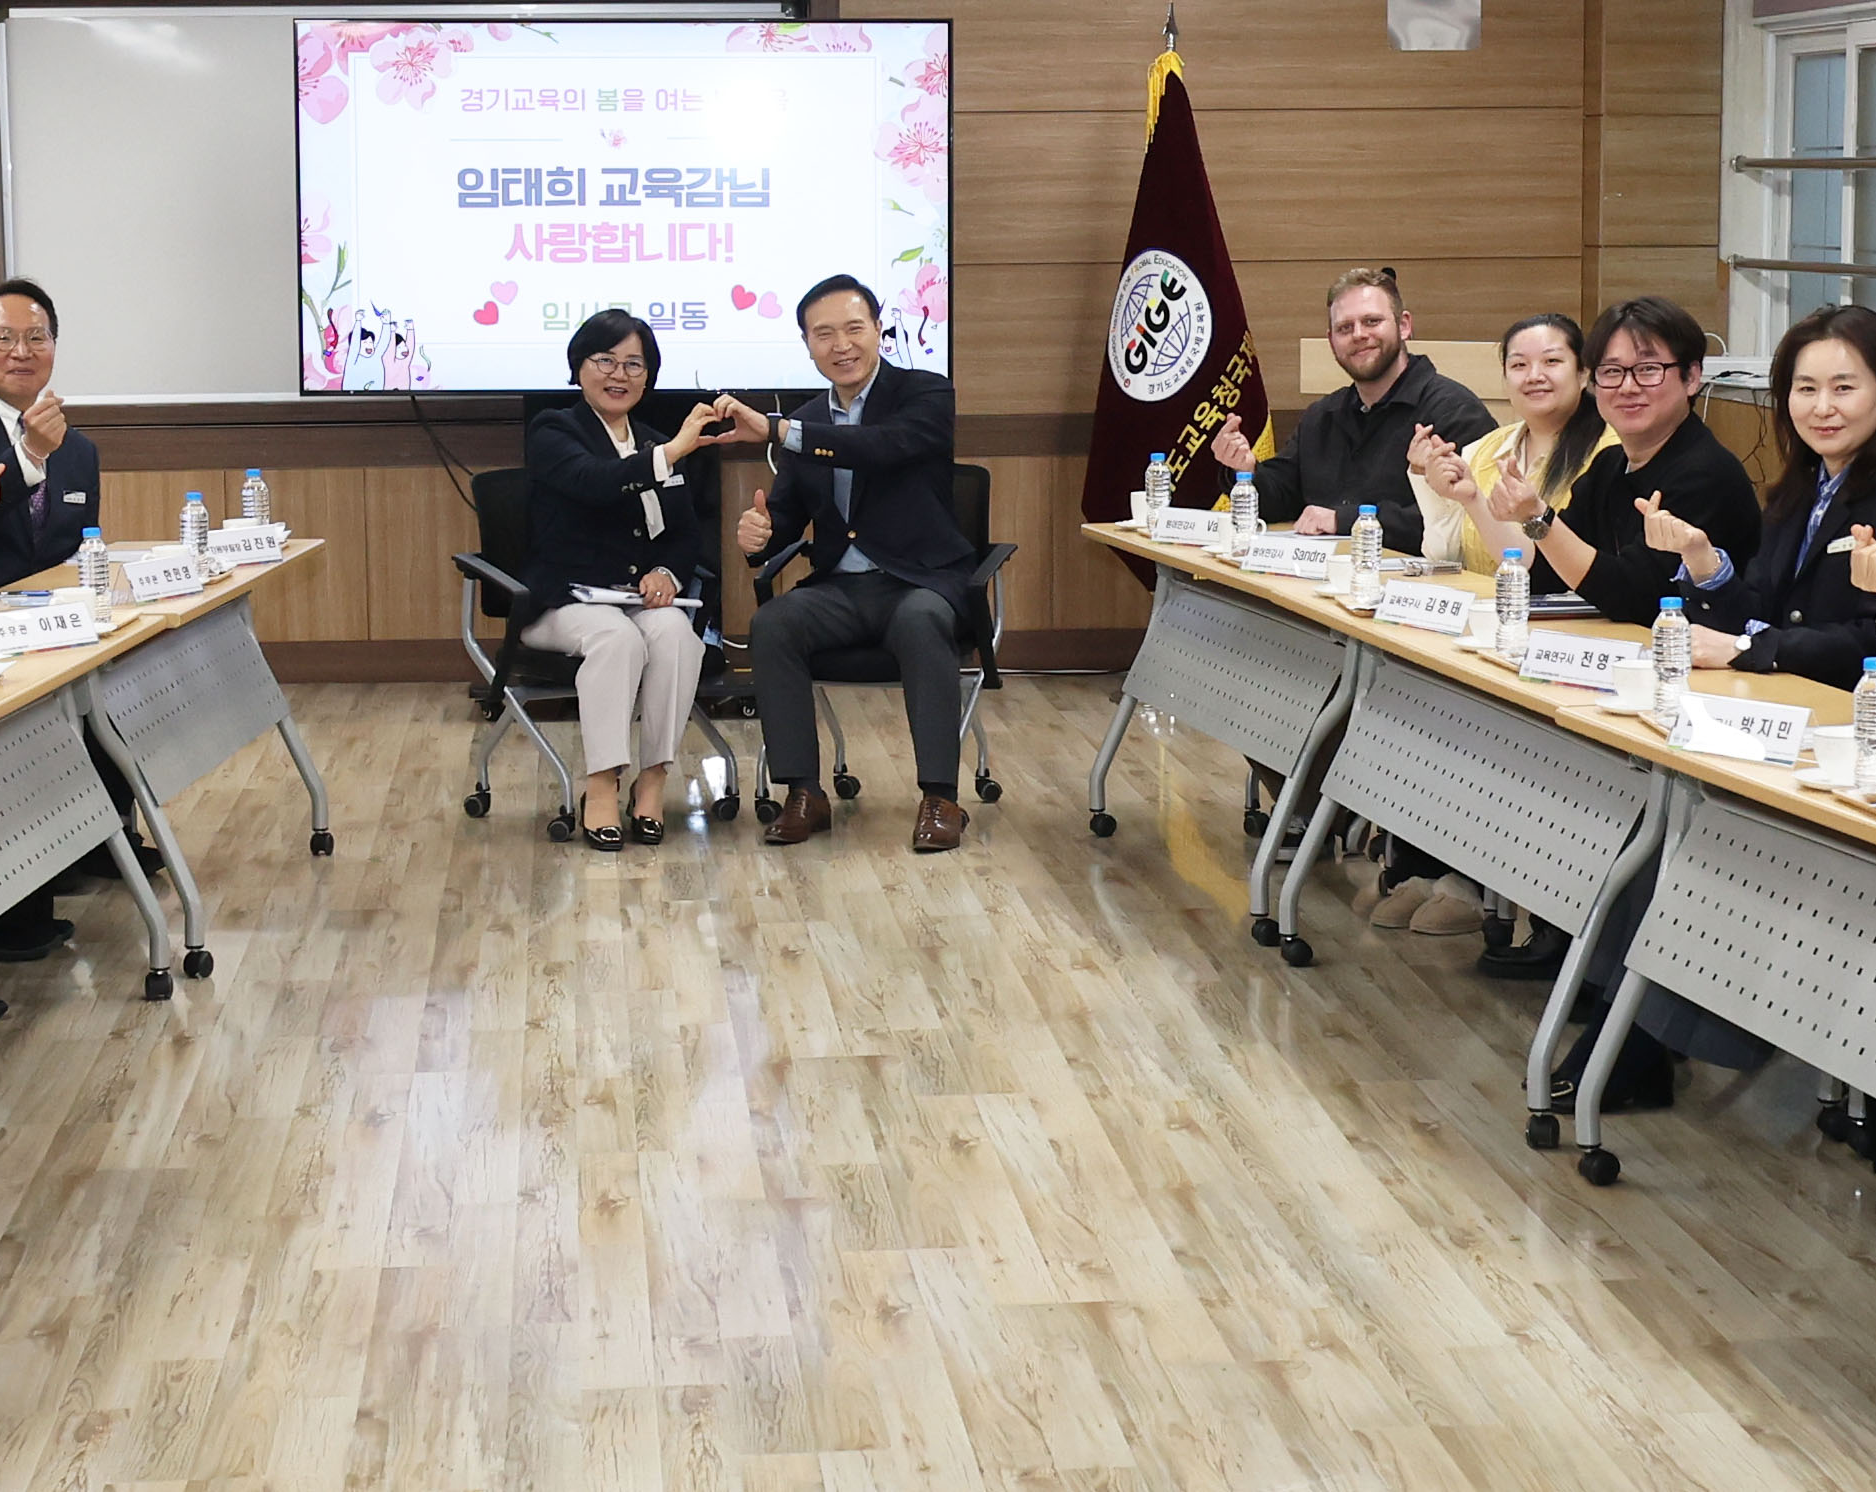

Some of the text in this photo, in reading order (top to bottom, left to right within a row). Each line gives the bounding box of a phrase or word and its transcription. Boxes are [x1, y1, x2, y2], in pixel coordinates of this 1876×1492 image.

[460, 88, 586, 112] 경기교육의
[596, 88, 645, 112] 봄을
[655, 88, 705, 112] 여는
[457, 166, 770, 208] 임태희 교육감님
[504, 222, 734, 263] 사랑합니다!
[648, 301, 709, 330] 일동
[1207, 519, 1219, 533] Va
[1292, 547, 1327, 563] Sandra
